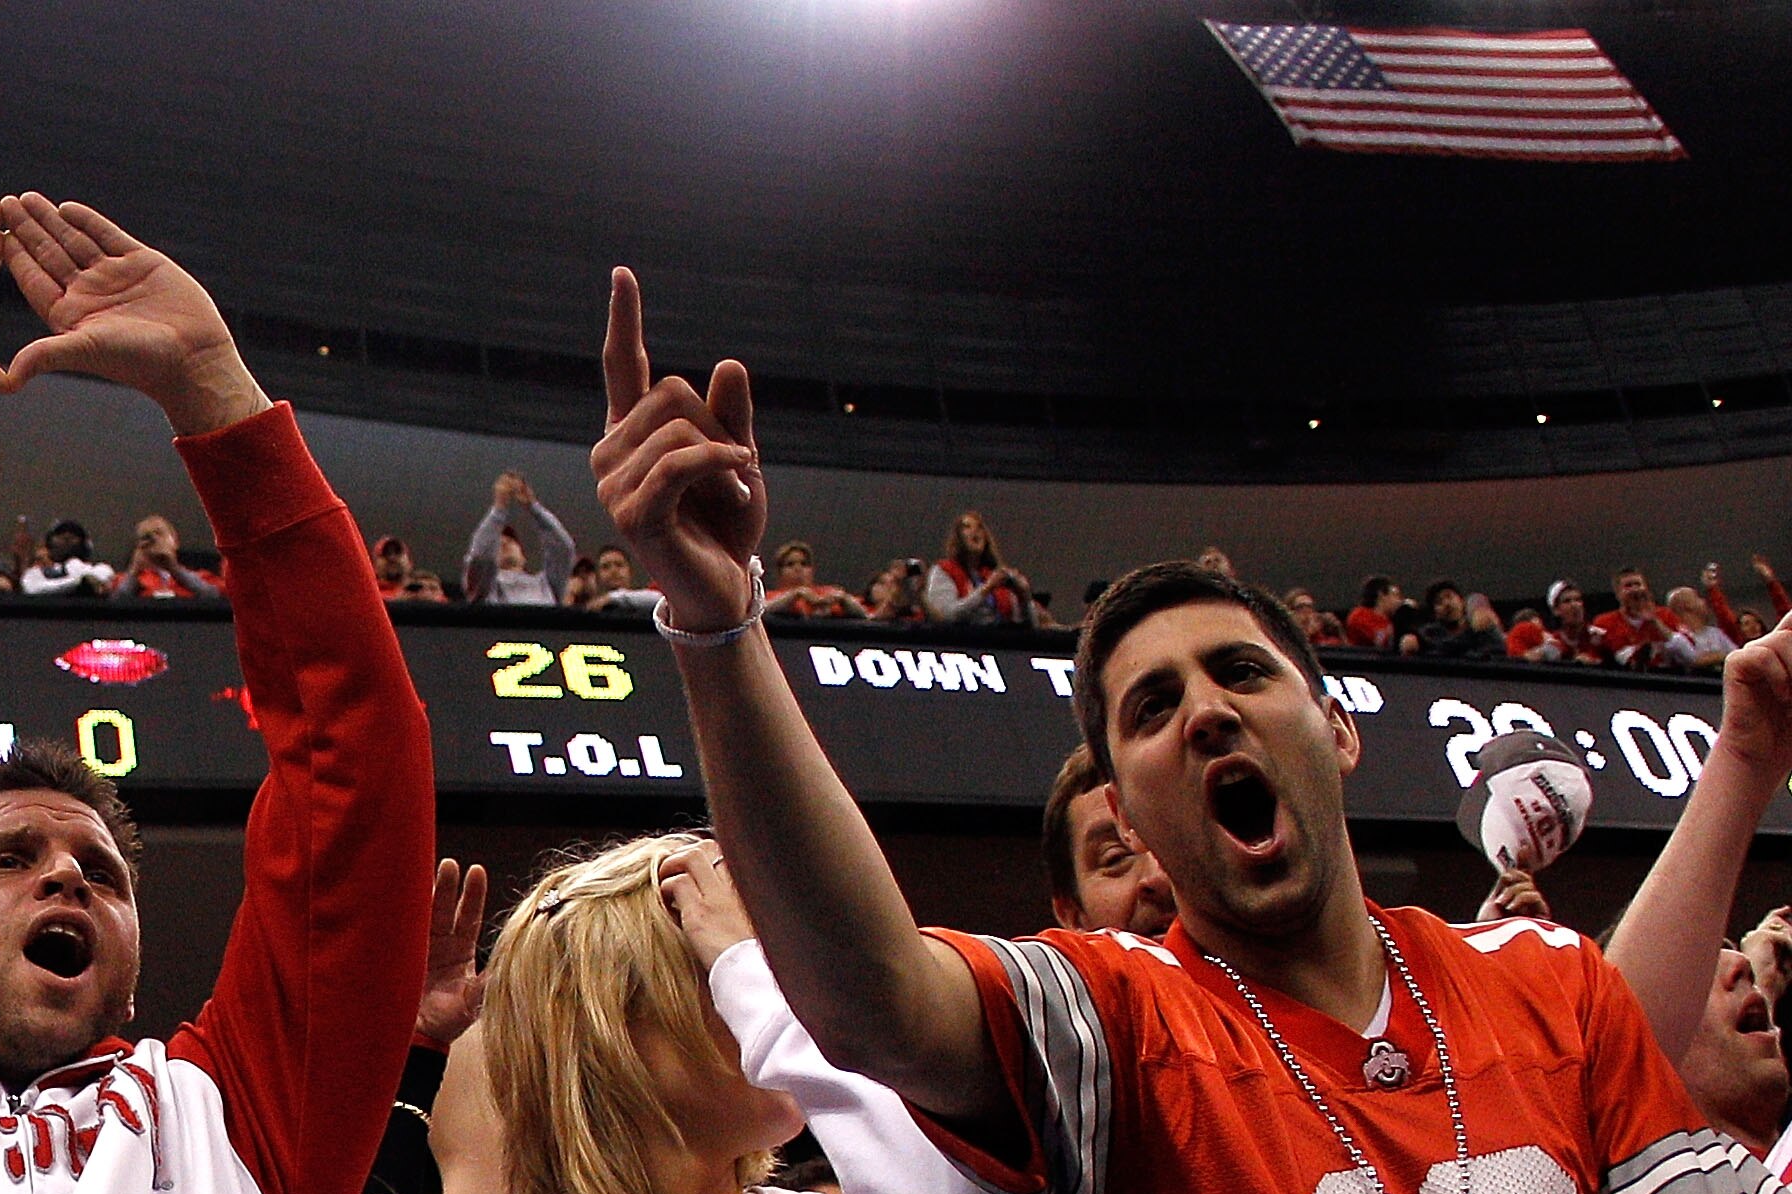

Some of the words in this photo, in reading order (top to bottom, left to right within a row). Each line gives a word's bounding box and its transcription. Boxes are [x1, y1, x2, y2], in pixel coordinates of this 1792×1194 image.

[486, 642, 634, 701] 26
[808, 646, 1007, 694] DOWN
[76, 708, 137, 778] 0
[489, 731, 682, 778] T.O.L
